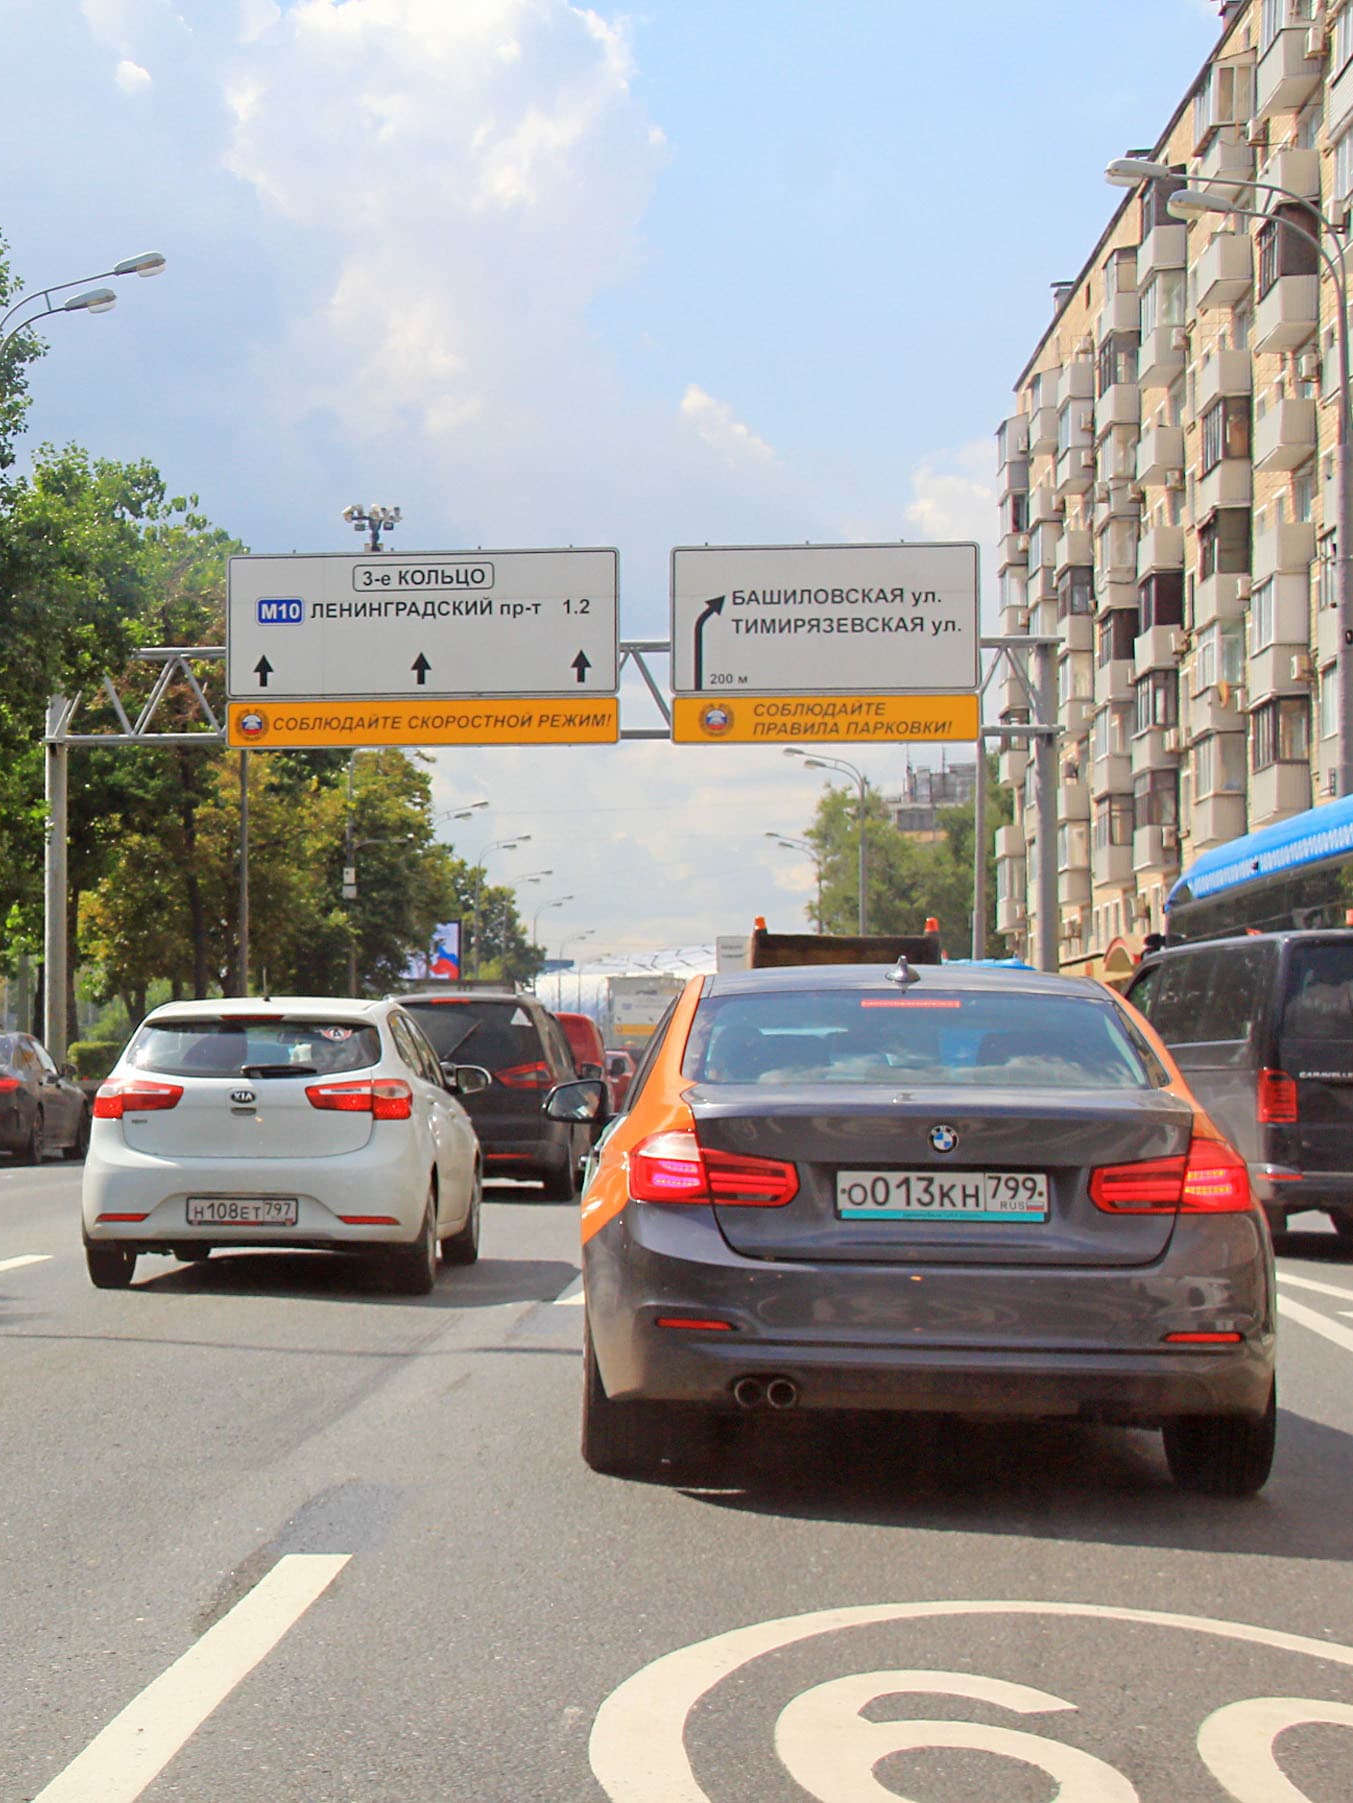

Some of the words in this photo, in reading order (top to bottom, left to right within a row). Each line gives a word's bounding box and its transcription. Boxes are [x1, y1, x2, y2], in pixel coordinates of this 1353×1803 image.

[363, 570, 391, 587] 3-е
[398, 567, 485, 589] КОЛЬЦО
[732, 588, 904, 606] БАШИЛОВСКАЯ
[911, 590, 942, 607] ул.
[260, 603, 300, 620] М10
[310, 597, 494, 620] ЛЕНИНГРАДСКИЙ
[499, 602, 541, 619] пр-т
[562, 599, 590, 615] 1.2
[731, 616, 924, 635] ТИМИРЯЗЕВСКАЯ
[931, 619, 962, 637] ул.
[710, 673, 734, 685] 200
[737, 675, 748, 684] м
[753, 701, 887, 718] СОБЛЮДАЙТЕ
[273, 714, 402, 731] СОБЛЮДАЙТЕ
[408, 713, 533, 730] СКОРОСТНОЙ
[538, 712, 612, 729] РЕЖИМ!
[753, 721, 840, 736] ПРАВИЛА
[846, 719, 953, 735] ПАРКОВКИ!
[233, 1091, 253, 1101] KIA
[987, 1175, 1038, 1200] 799
[265, 1202, 291, 1216] 797
[1000, 1201, 1025, 1210] RUS
